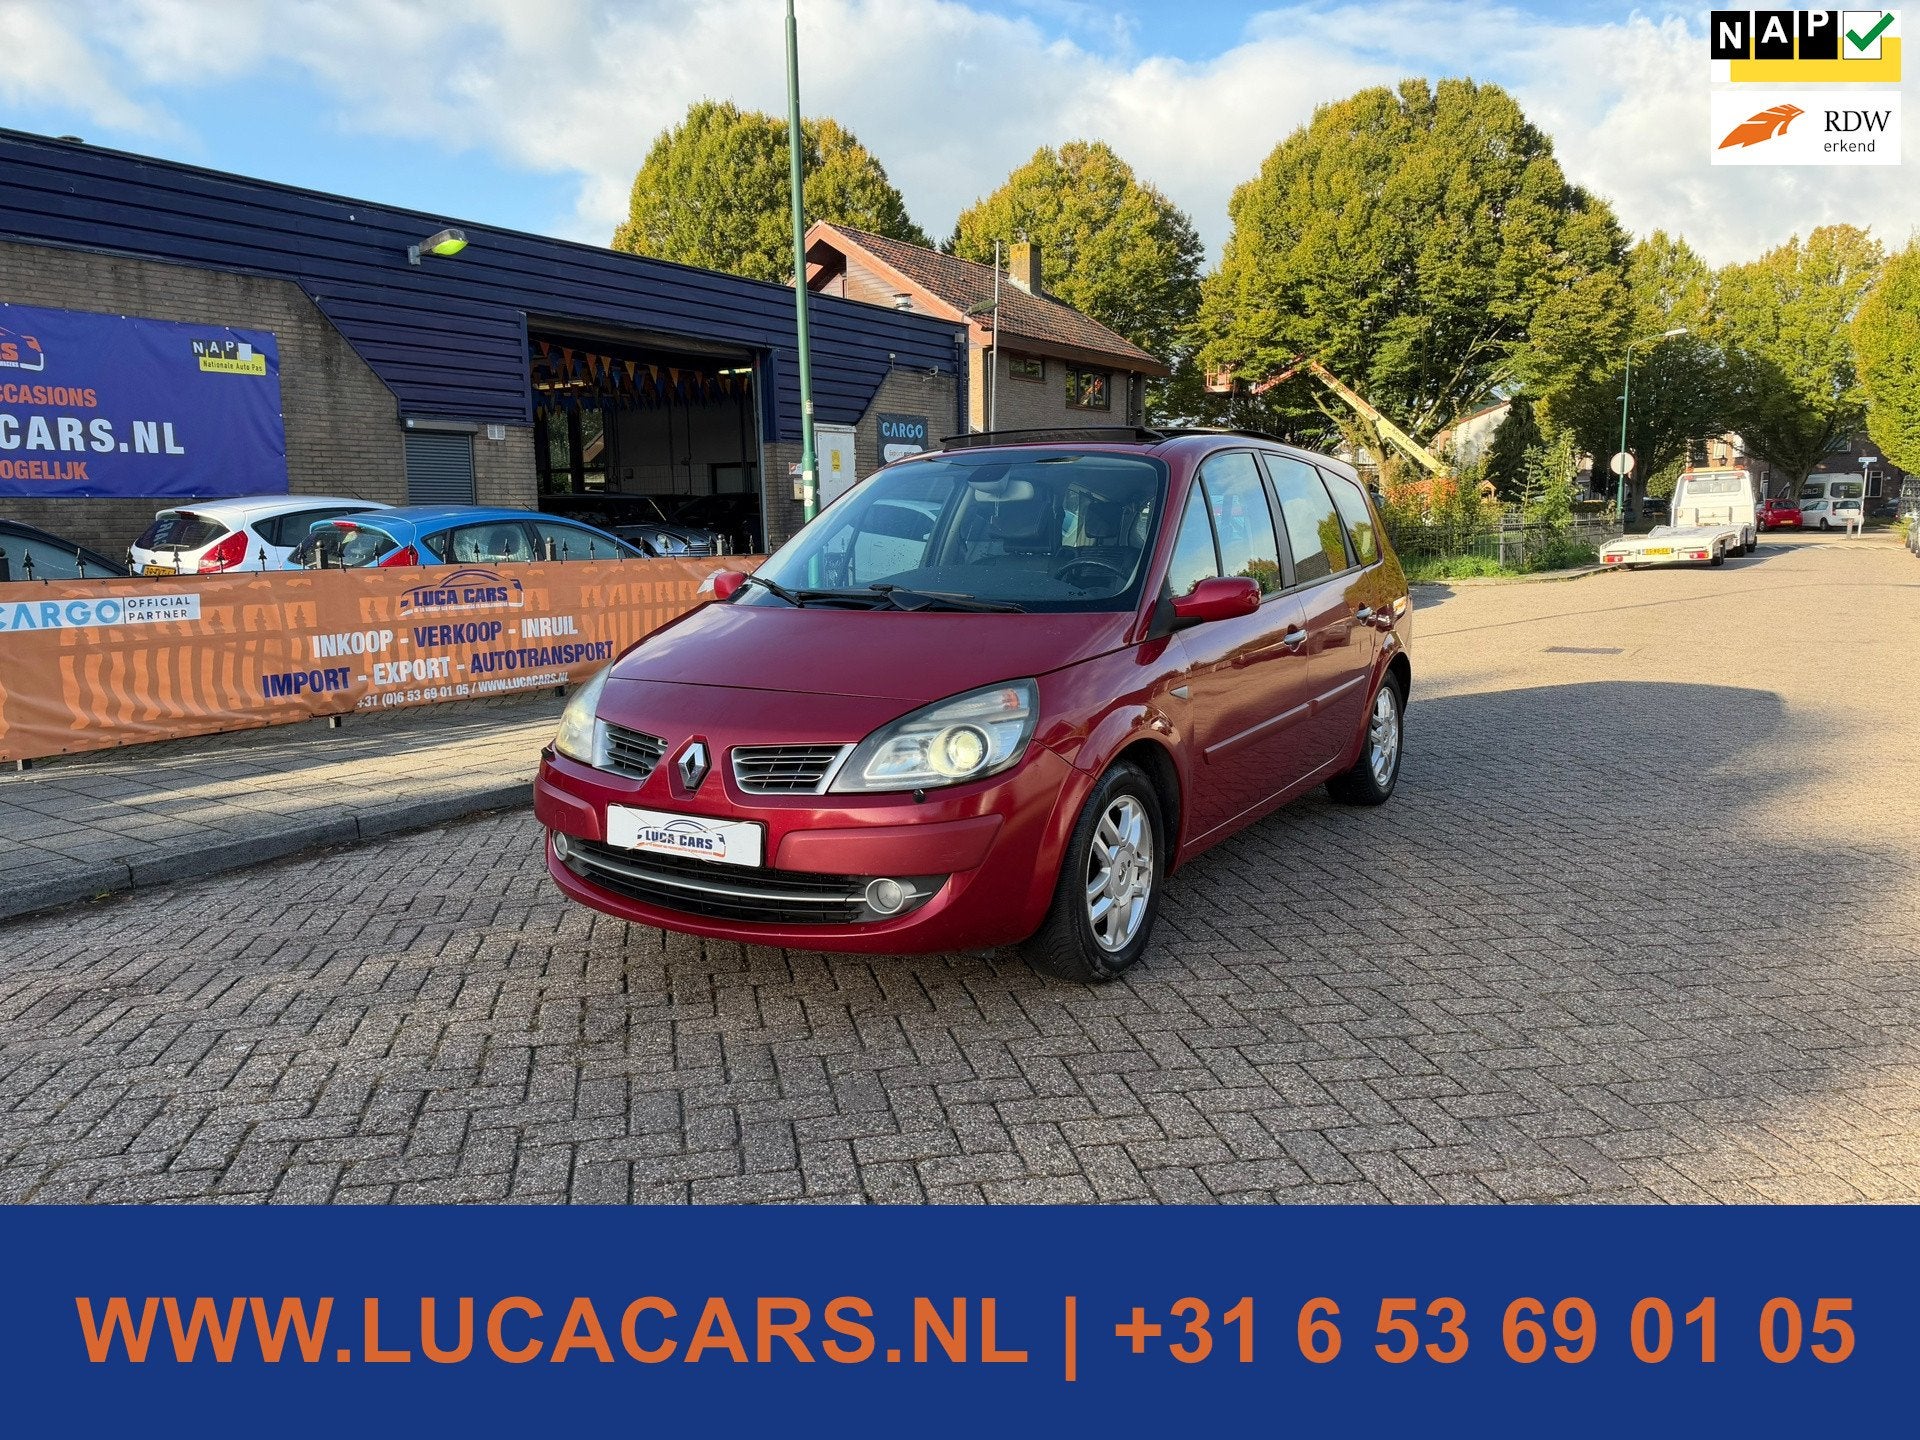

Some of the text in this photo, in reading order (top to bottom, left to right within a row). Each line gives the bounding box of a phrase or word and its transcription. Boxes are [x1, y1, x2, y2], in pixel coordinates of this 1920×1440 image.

[192, 341, 235, 354] NAP
[0, 383, 98, 408] CASIONS
[882, 421, 924, 438] CARGO
[128, 597, 190, 609] OFFICIAL
[413, 586, 508, 607] LUCA CARS
[129, 609, 188, 622] PARTNER
[312, 629, 394, 659] INKOOP
[413, 620, 502, 648] VERKOOP
[521, 615, 579, 639] INRUIL
[262, 666, 351, 698] IMPORT
[373, 656, 450, 686] EXPORT
[470, 640, 614, 674] AUTOTRANSPORT
[357, 694, 379, 708] +31
[381, 691, 405, 708] (0)6
[406, 689, 421, 702] 53
[423, 687, 438, 700] 69
[440, 685, 453, 698] 01
[455, 683, 470, 696] 05
[478, 671, 570, 693] WWW.LUCACARS.NL
[645, 829, 675, 845] LUCA
[679, 834, 714, 850] CARS
